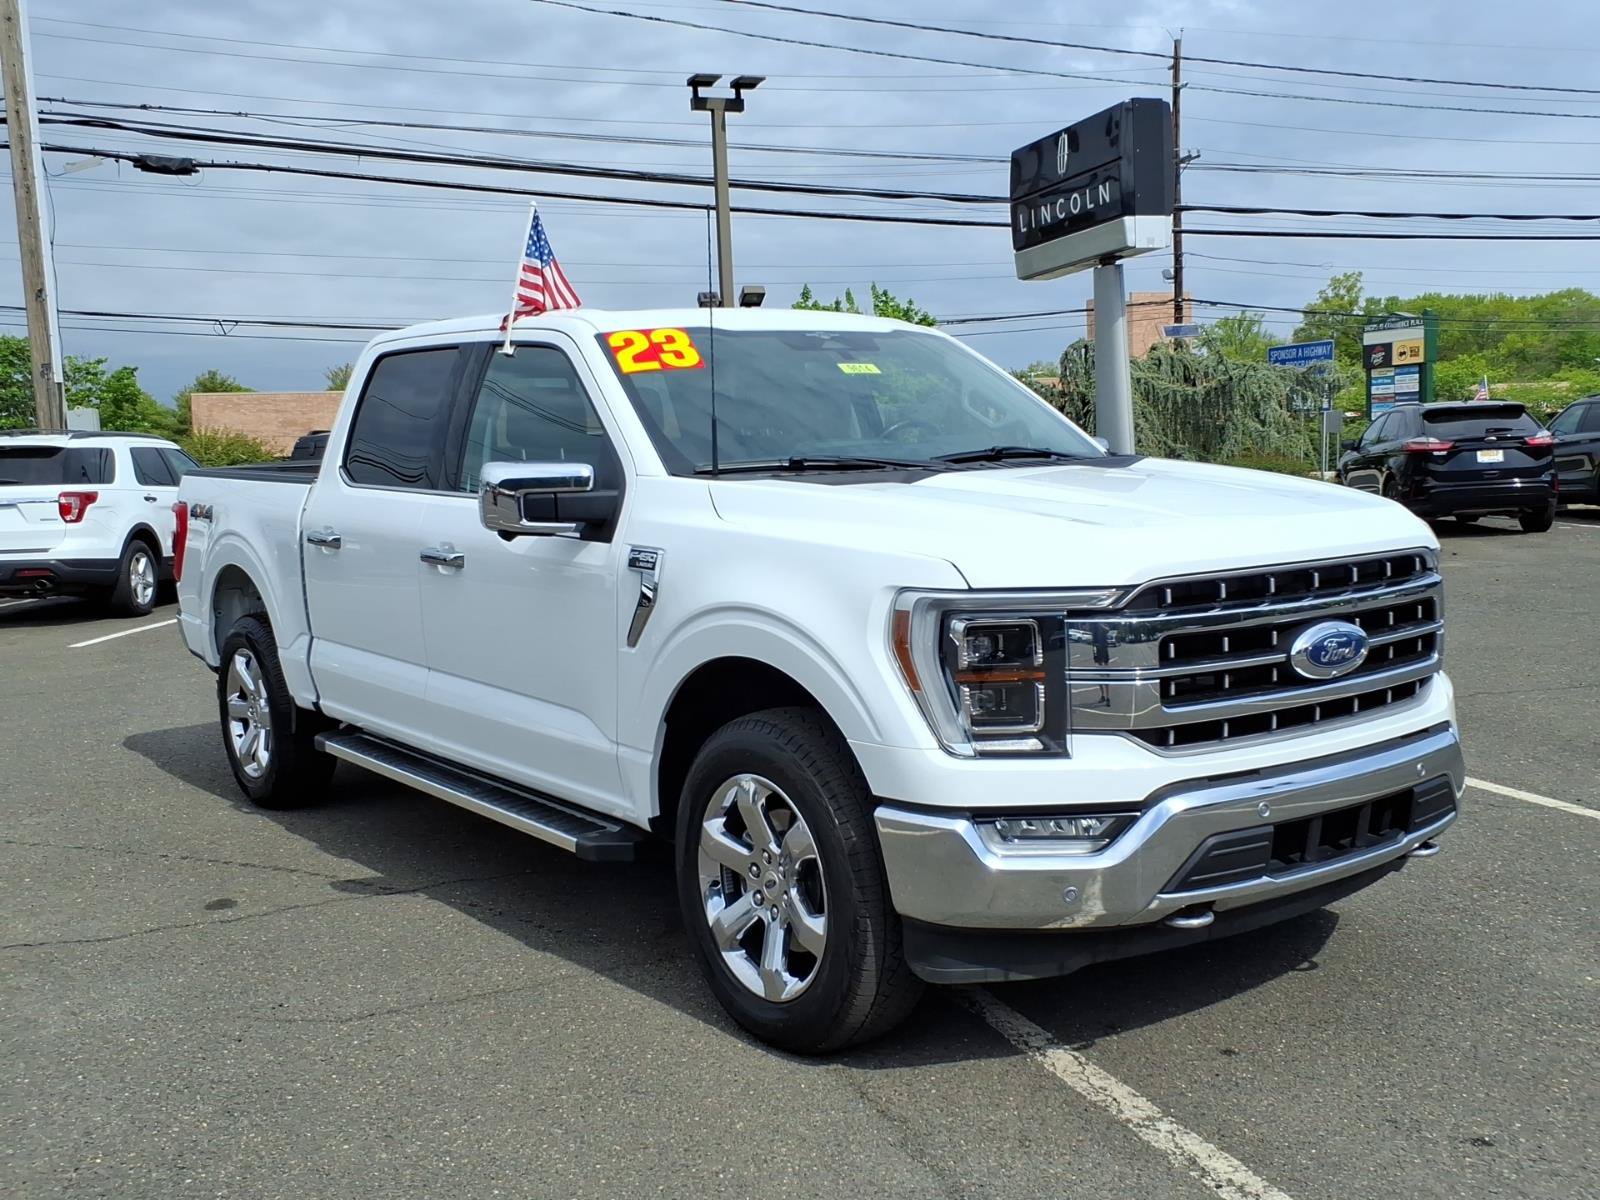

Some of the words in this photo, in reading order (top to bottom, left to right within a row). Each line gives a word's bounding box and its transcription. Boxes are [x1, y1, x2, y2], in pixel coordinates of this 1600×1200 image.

[1018, 182, 1111, 233] LINCOLN
[608, 329, 699, 375] 23
[1270, 348, 1297, 361] SPONSOR
[1297, 347, 1303, 358] A
[1303, 344, 1331, 357] HIGHWAY
[1320, 637, 1356, 663] Ford
